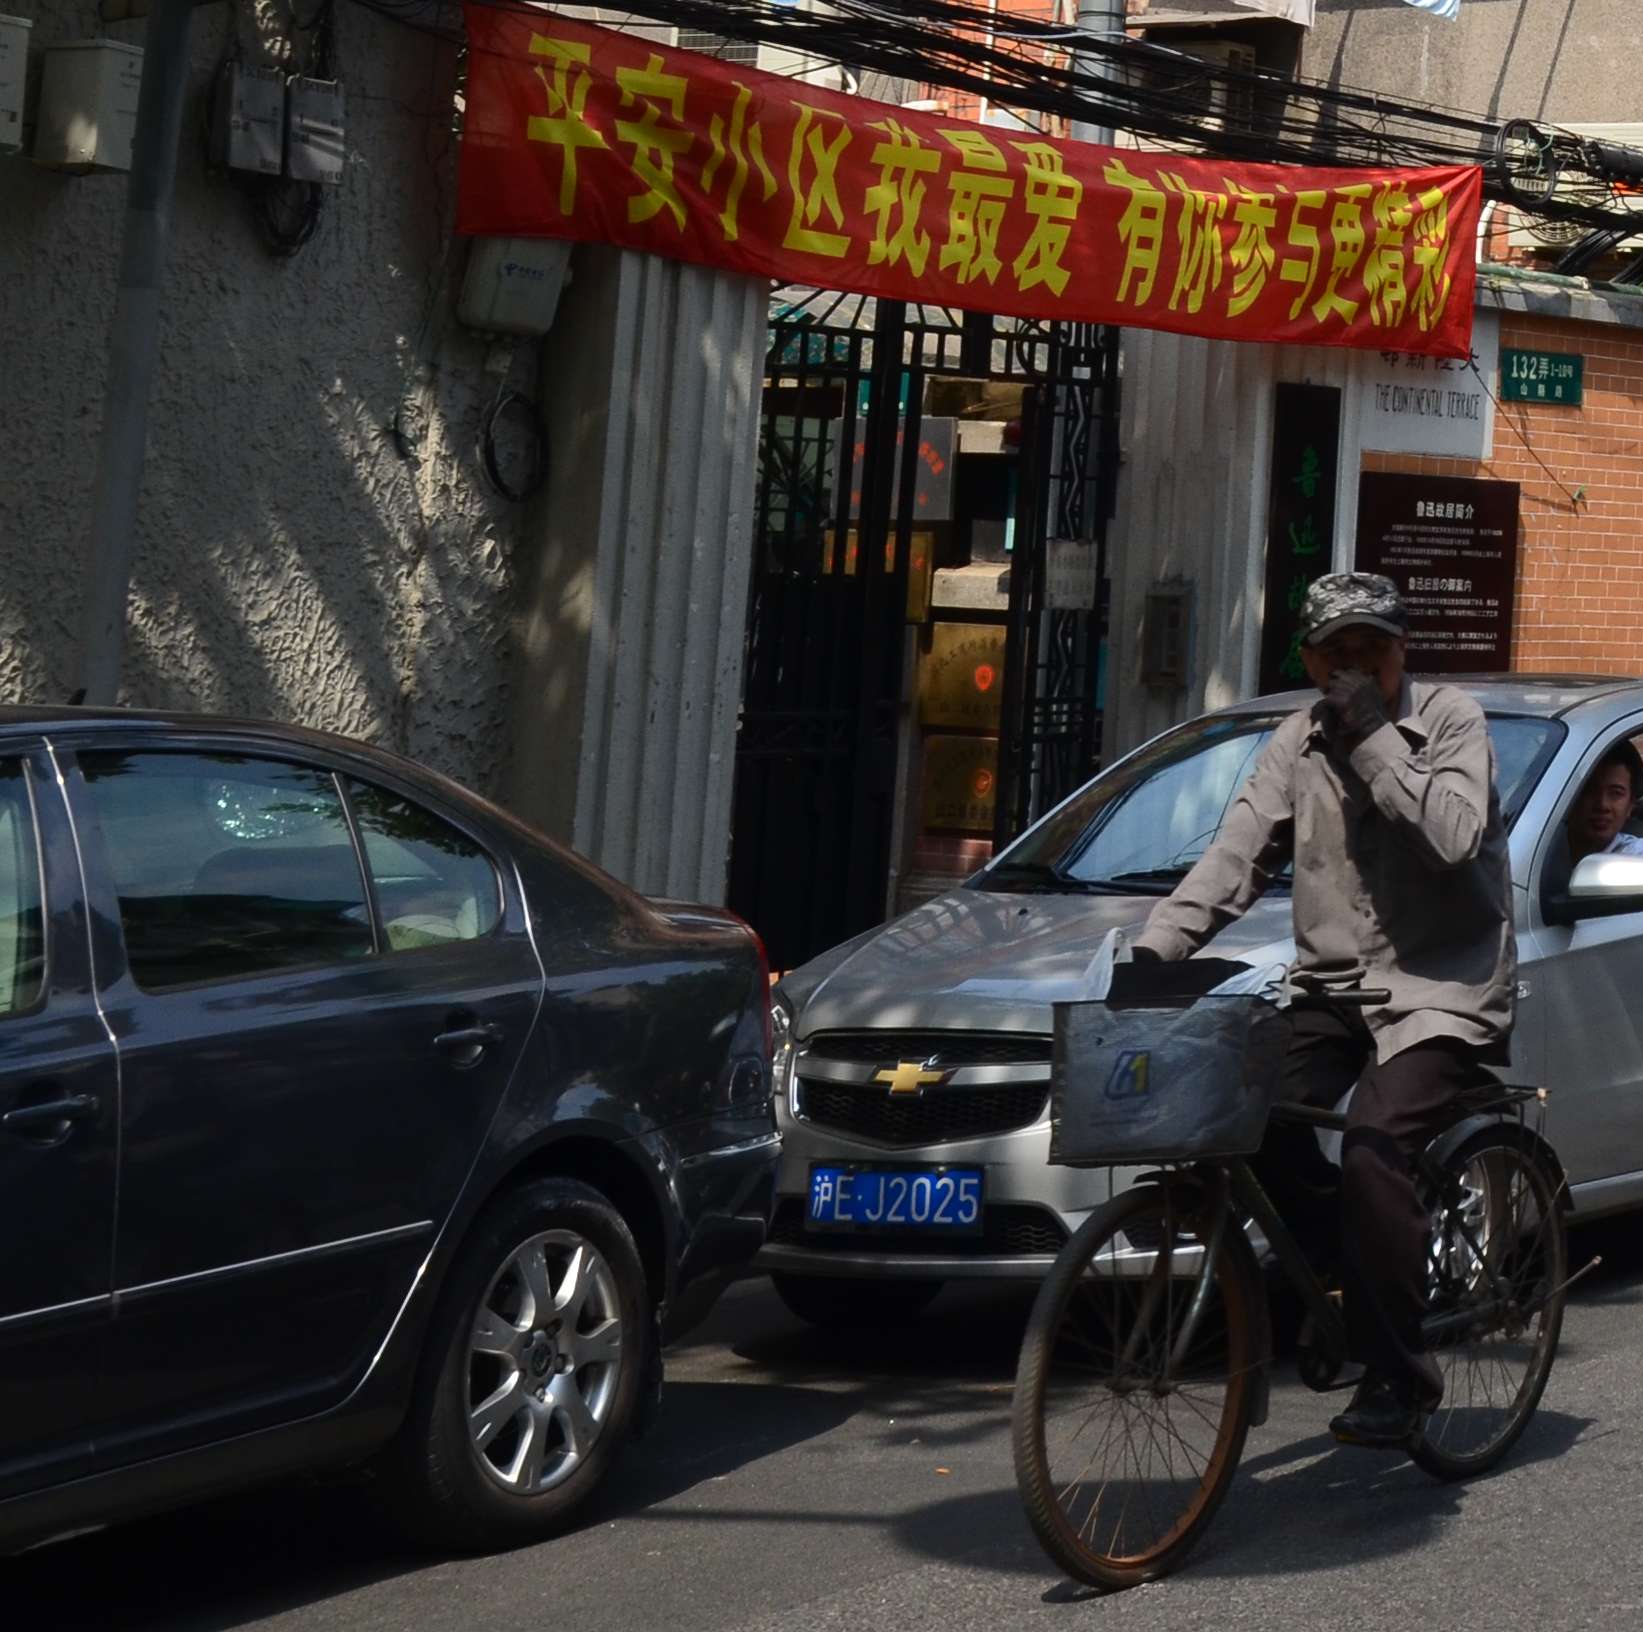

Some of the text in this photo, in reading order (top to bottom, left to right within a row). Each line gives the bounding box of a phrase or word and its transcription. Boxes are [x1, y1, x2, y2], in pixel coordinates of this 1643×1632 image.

[526, 29, 1450, 333] 平安小区我最爱 有你参与更精彩
[1511, 355, 1549, 380] 132弄
[1376, 384, 1480, 420] THE CONTINENTAL TERRACE
[812, 1176, 979, 1224] 沪E·J2025
